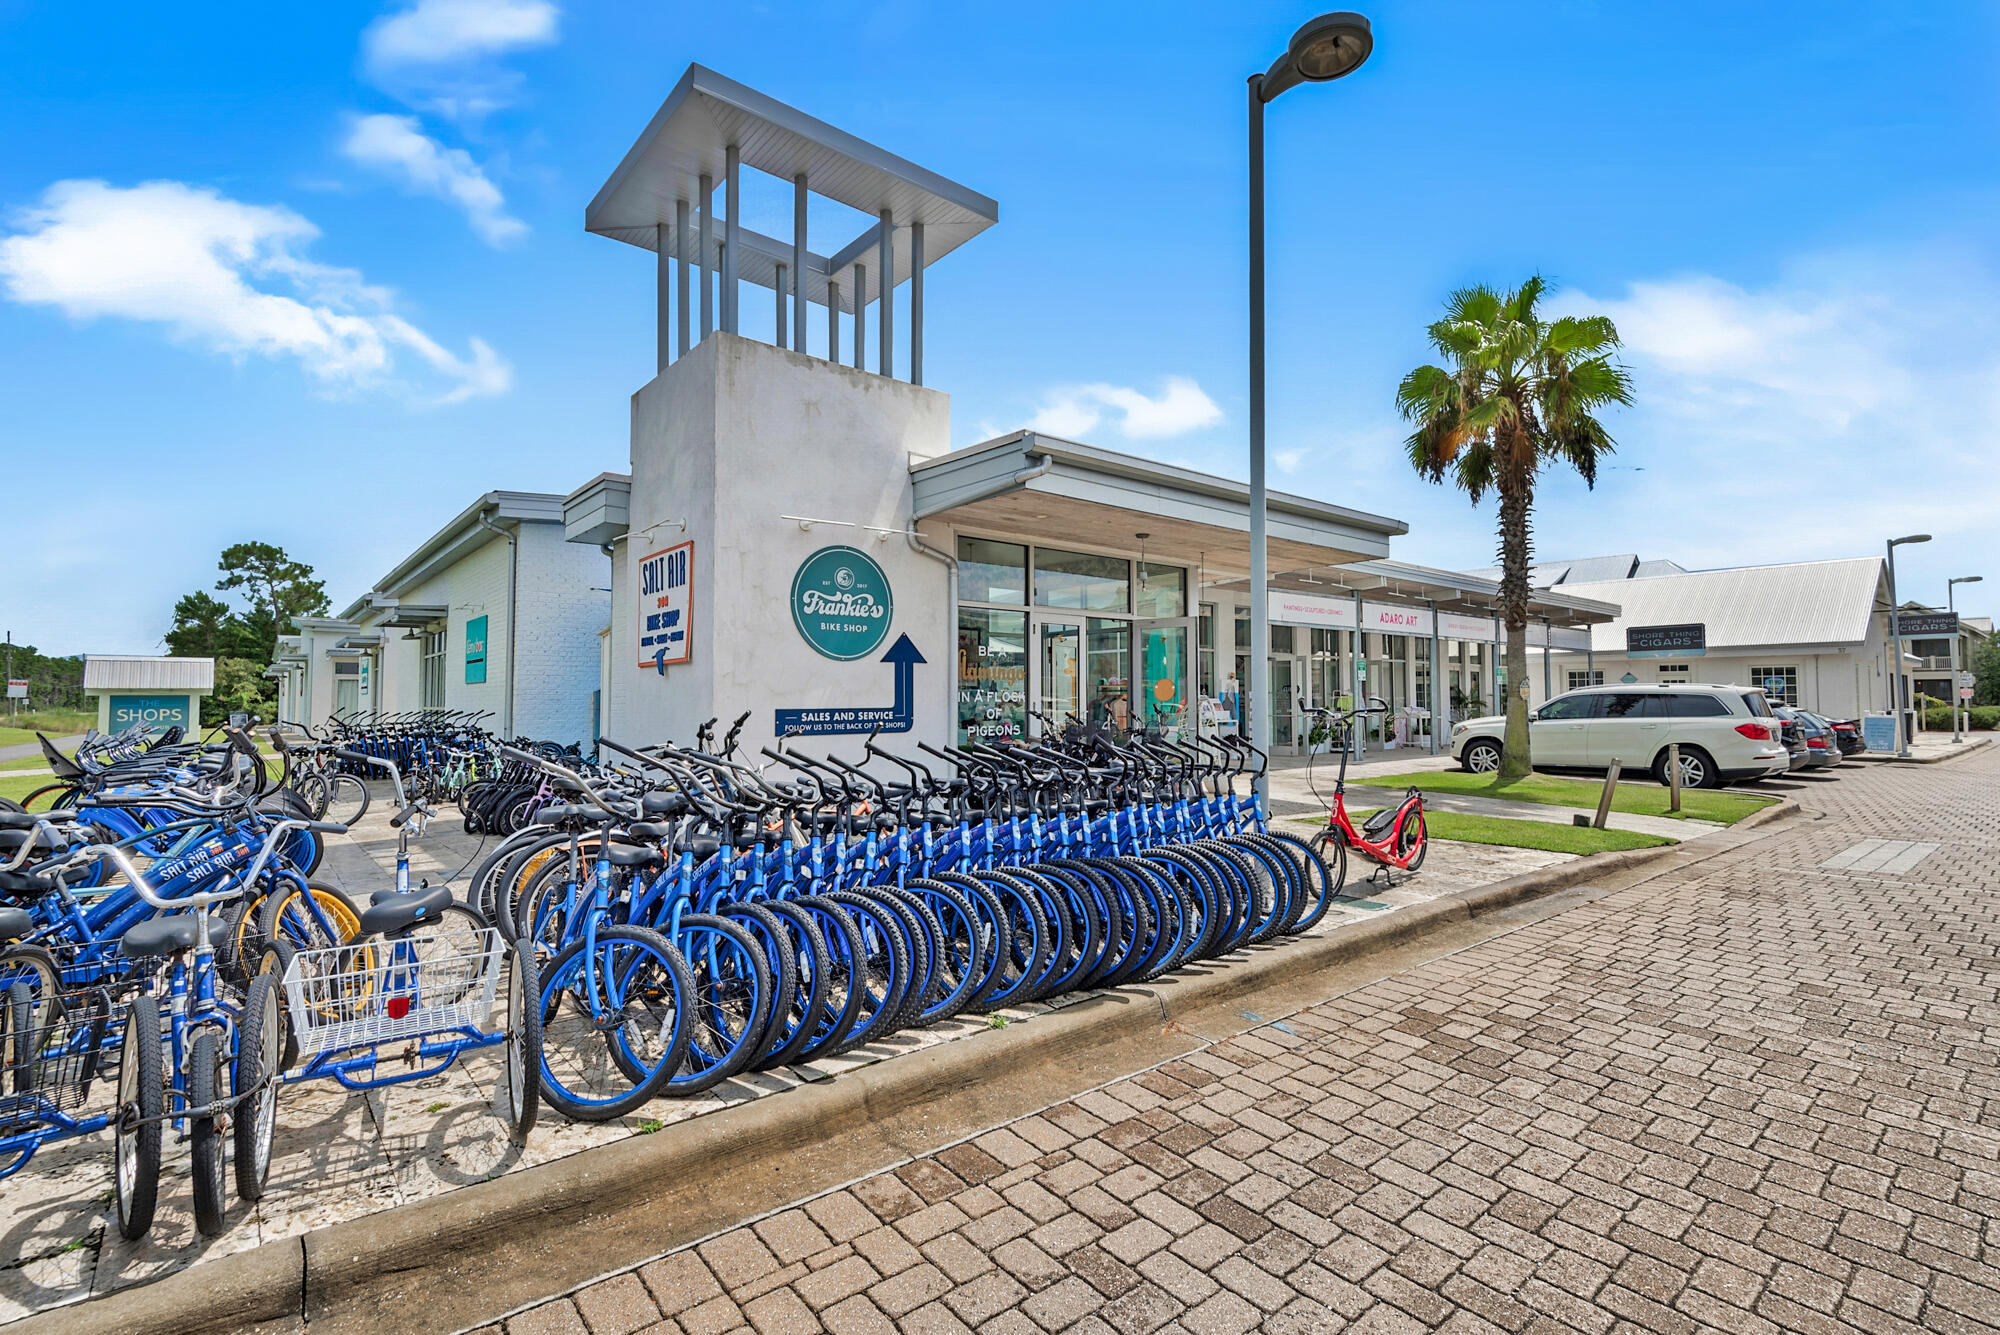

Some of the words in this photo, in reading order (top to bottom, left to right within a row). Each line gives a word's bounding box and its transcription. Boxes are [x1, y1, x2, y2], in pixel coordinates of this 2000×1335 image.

[643, 557, 664, 596] SALT
[668, 550, 686, 589] AIR
[661, 609, 680, 629] SHOP
[1380, 613, 1403, 625] ADARO
[1405, 616, 1418, 626] ART
[820, 622, 840, 631] BIKE
[844, 624, 868, 633] SHOP
[1900, 623, 1948, 632] CIGARS
[1631, 632, 1664, 640] SHORE
[1669, 630, 1700, 638] THING
[1640, 637, 1692, 647] CIGARS
[958, 691, 970, 702] IN
[974, 691, 983, 702] A
[987, 691, 1026, 703] FLOCK
[116, 708, 182, 721] SHOPS
[801, 712, 829, 722] SALES
[833, 712, 855, 721] AND
[858, 711, 893, 720] SERVICE
[986, 708, 1002, 719] OF
[846, 722, 862, 730] BACK
[967, 725, 1021, 737] PIGEONS
[160, 860, 188, 881] SALT
[188, 850, 210, 867] AIR
[186, 862, 214, 883] SALT
[214, 851, 235, 868] AIR
